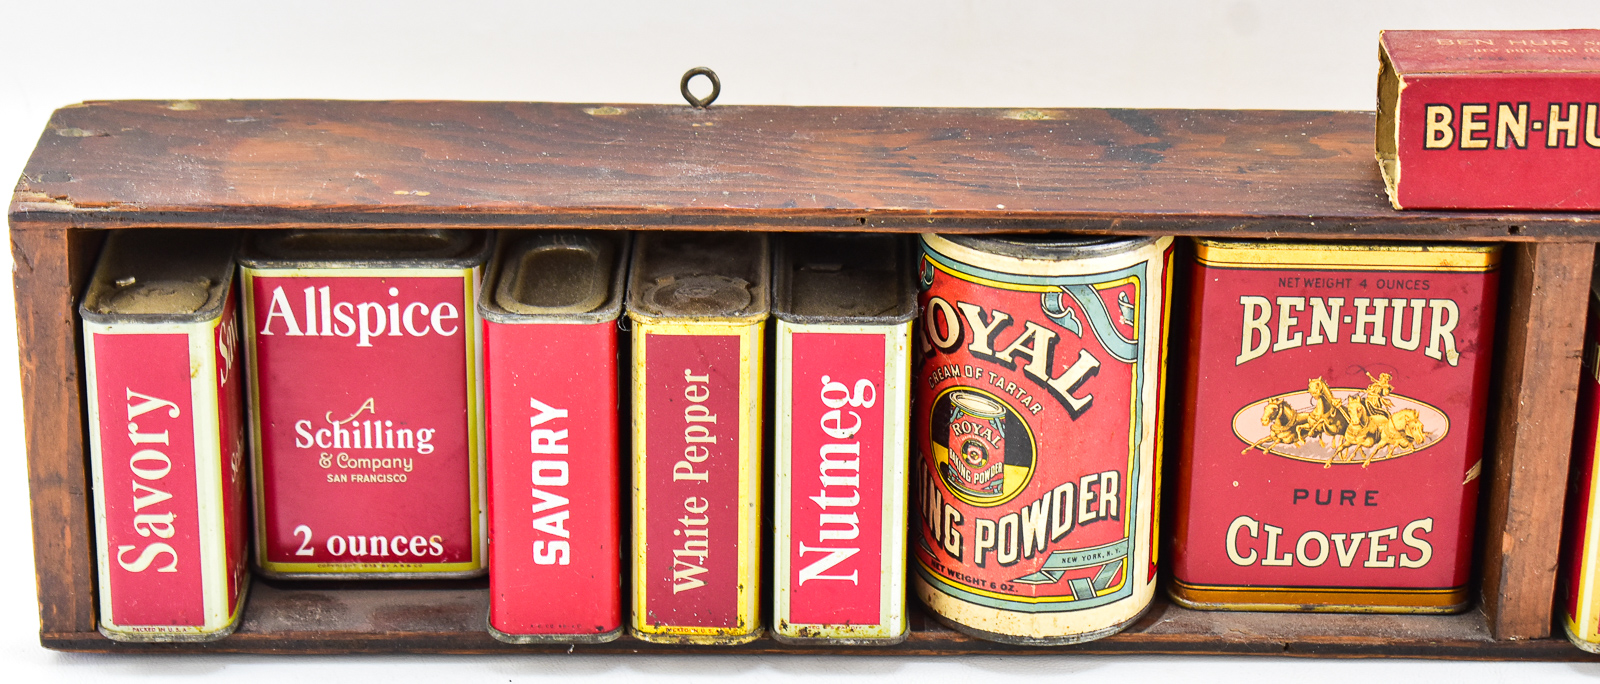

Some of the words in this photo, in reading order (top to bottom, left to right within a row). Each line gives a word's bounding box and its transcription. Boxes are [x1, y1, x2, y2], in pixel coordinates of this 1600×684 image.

[1423, 101, 1600, 150] BEN-HU
[1278, 277, 1301, 289] NET
[1303, 278, 1353, 290] WEIGHT
[1359, 279, 1368, 290] 4
[1376, 279, 1431, 291] OUNCES
[260, 285, 459, 347] Allspice
[1235, 295, 1460, 367] BEN-HUR
[928, 363, 962, 389] CREAM
[964, 364, 984, 380] OF
[988, 370, 1043, 416] TARTAR
[294, 418, 436, 455] Schilling
[673, 368, 717, 483] Pepper
[951, 420, 1002, 450] ROYAL
[117, 387, 181, 573] Savory
[318, 452, 333, 469] &
[336, 452, 413, 473] Company
[326, 473, 348, 483] SAN
[351, 473, 408, 484] FRANCISCO
[530, 397, 571, 566] SAVORY
[799, 374, 877, 587] Nutmeg
[949, 448, 972, 484] BAKING
[973, 461, 1004, 485] POWDER
[974, 470, 1121, 567] POWDER
[1292, 488, 1380, 507] PURE
[293, 523, 315, 557] 2
[326, 534, 444, 557] ounces
[673, 495, 710, 595] White
[1061, 556, 1079, 564] NEW
[1082, 553, 1105, 562] YORK,
[1225, 515, 1434, 569] CLOVES
[930, 559, 945, 574] NET
[947, 569, 986, 587] WEIGHT
[990, 580, 997, 590] 6
[1000, 584, 1019, 593] OZ.
